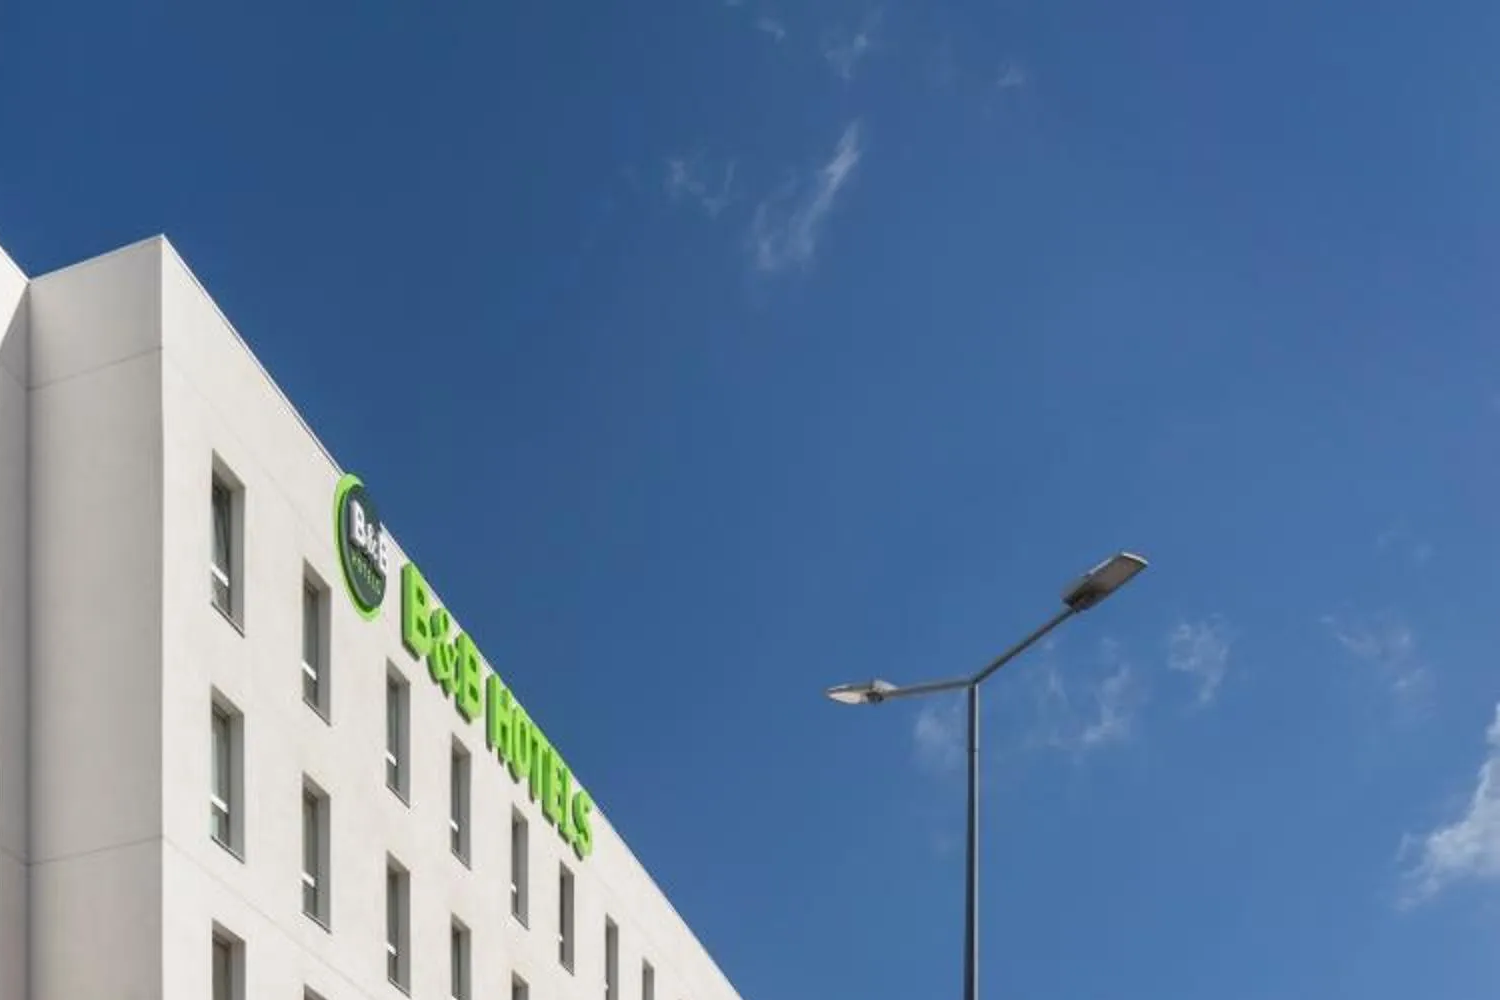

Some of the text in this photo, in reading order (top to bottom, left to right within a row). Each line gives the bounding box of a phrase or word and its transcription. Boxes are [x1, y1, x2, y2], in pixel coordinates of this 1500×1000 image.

[349, 499, 388, 577] B&B
[401, 562, 593, 861] B&B HOTELS
